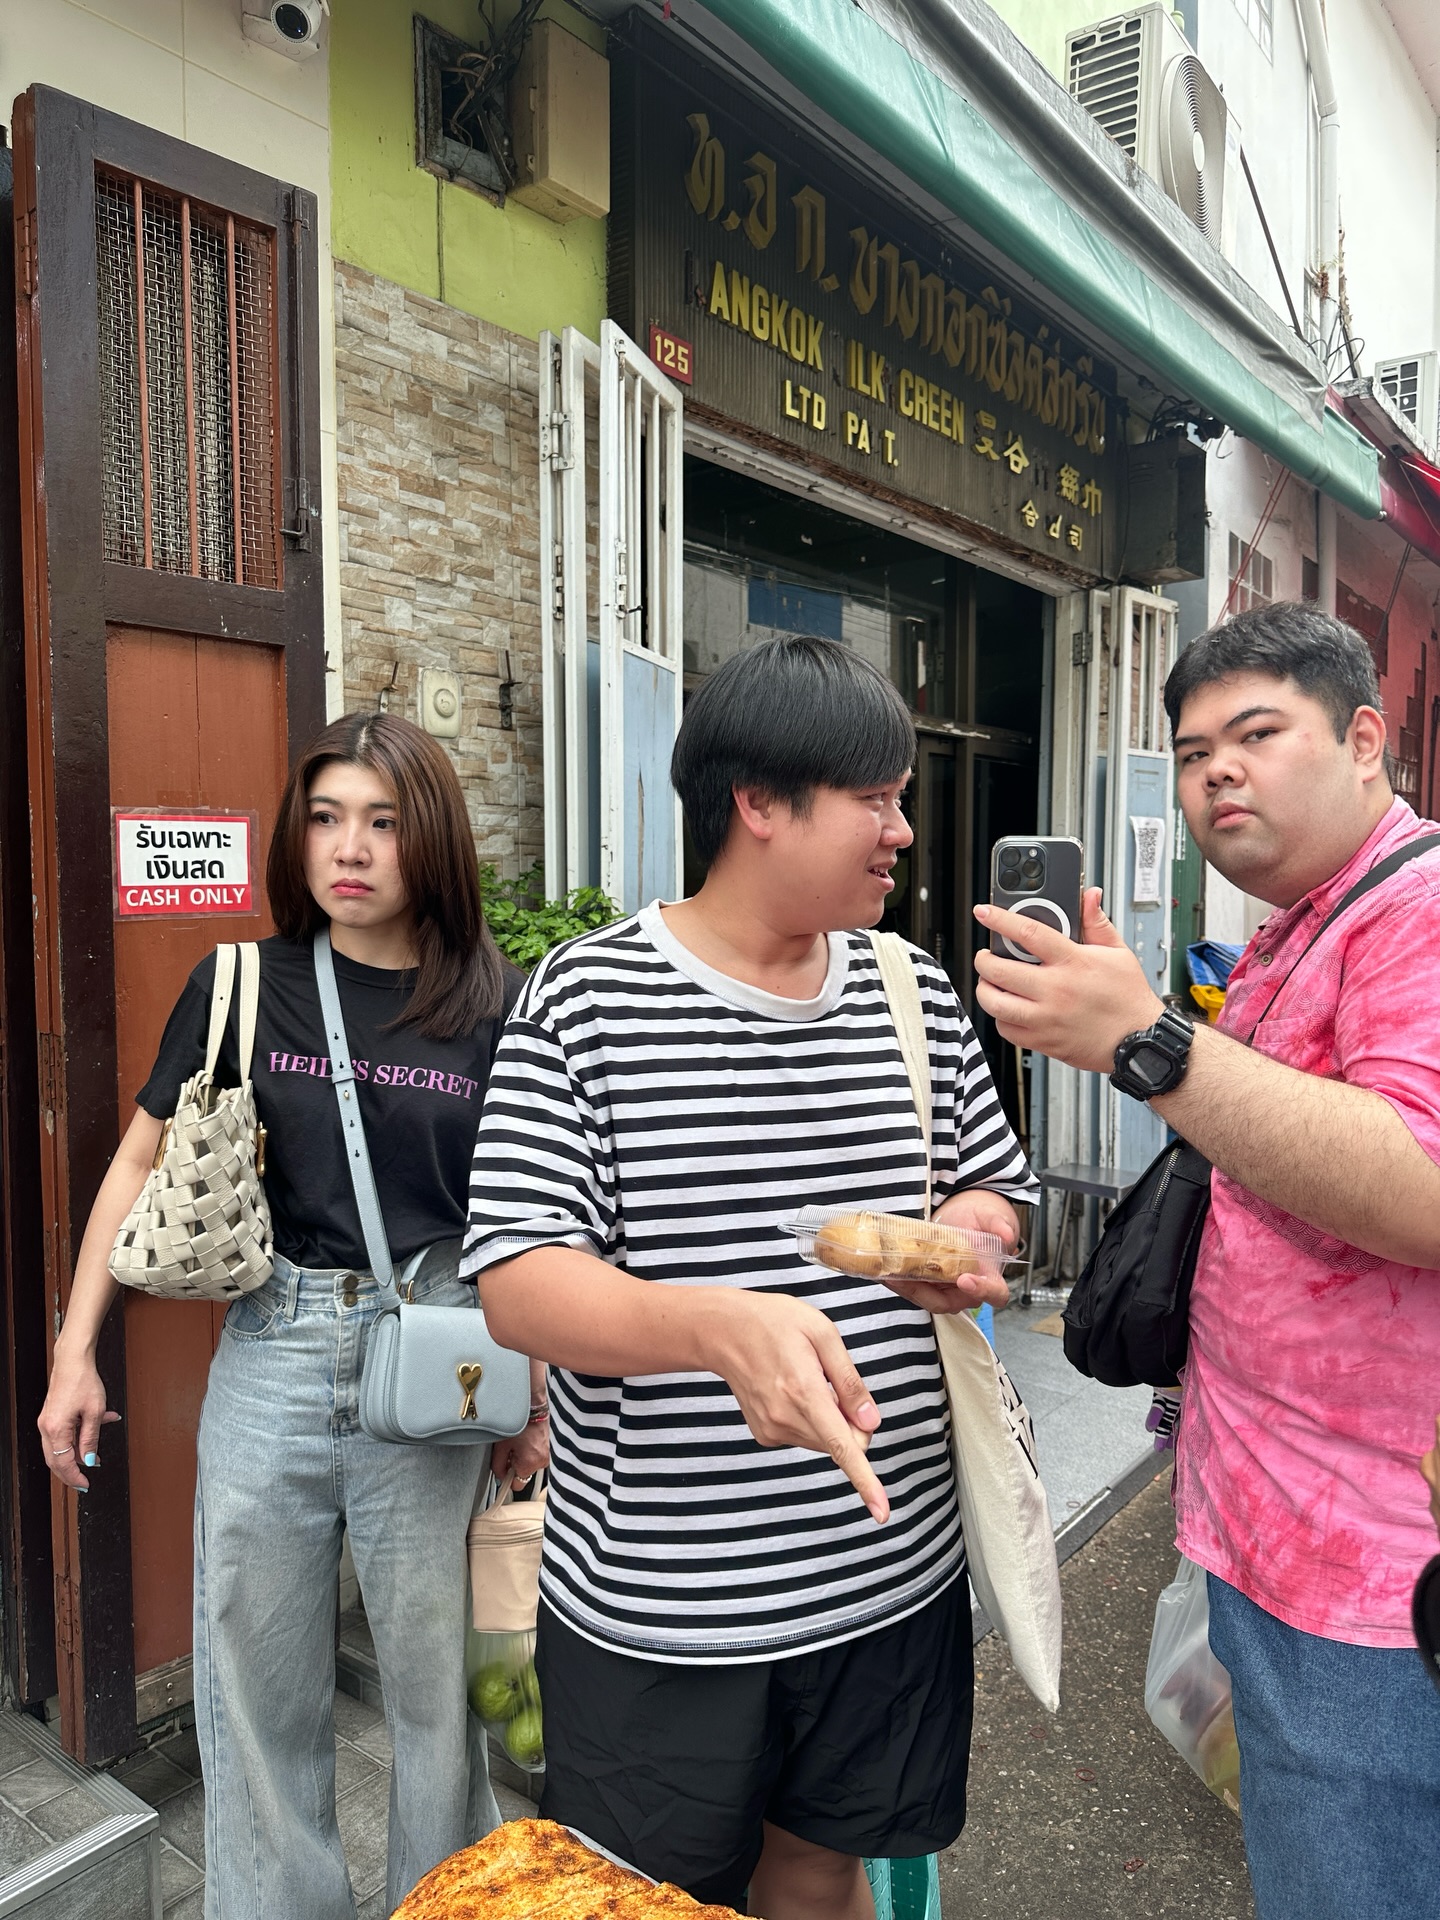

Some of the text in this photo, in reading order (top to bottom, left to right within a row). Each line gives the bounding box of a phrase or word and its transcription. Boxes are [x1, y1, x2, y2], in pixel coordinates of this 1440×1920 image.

[655, 334, 689, 375] 125
[708, 260, 965, 445] ANGKOK ILK CREEN
[784, 379, 826, 431] LTD
[136, 823, 232, 849] รับเฉพาะ
[146, 854, 225, 879] เงินสด
[126, 887, 245, 907] CASH ONLY
[269, 1051, 479, 1100] HEID'S SECRET
